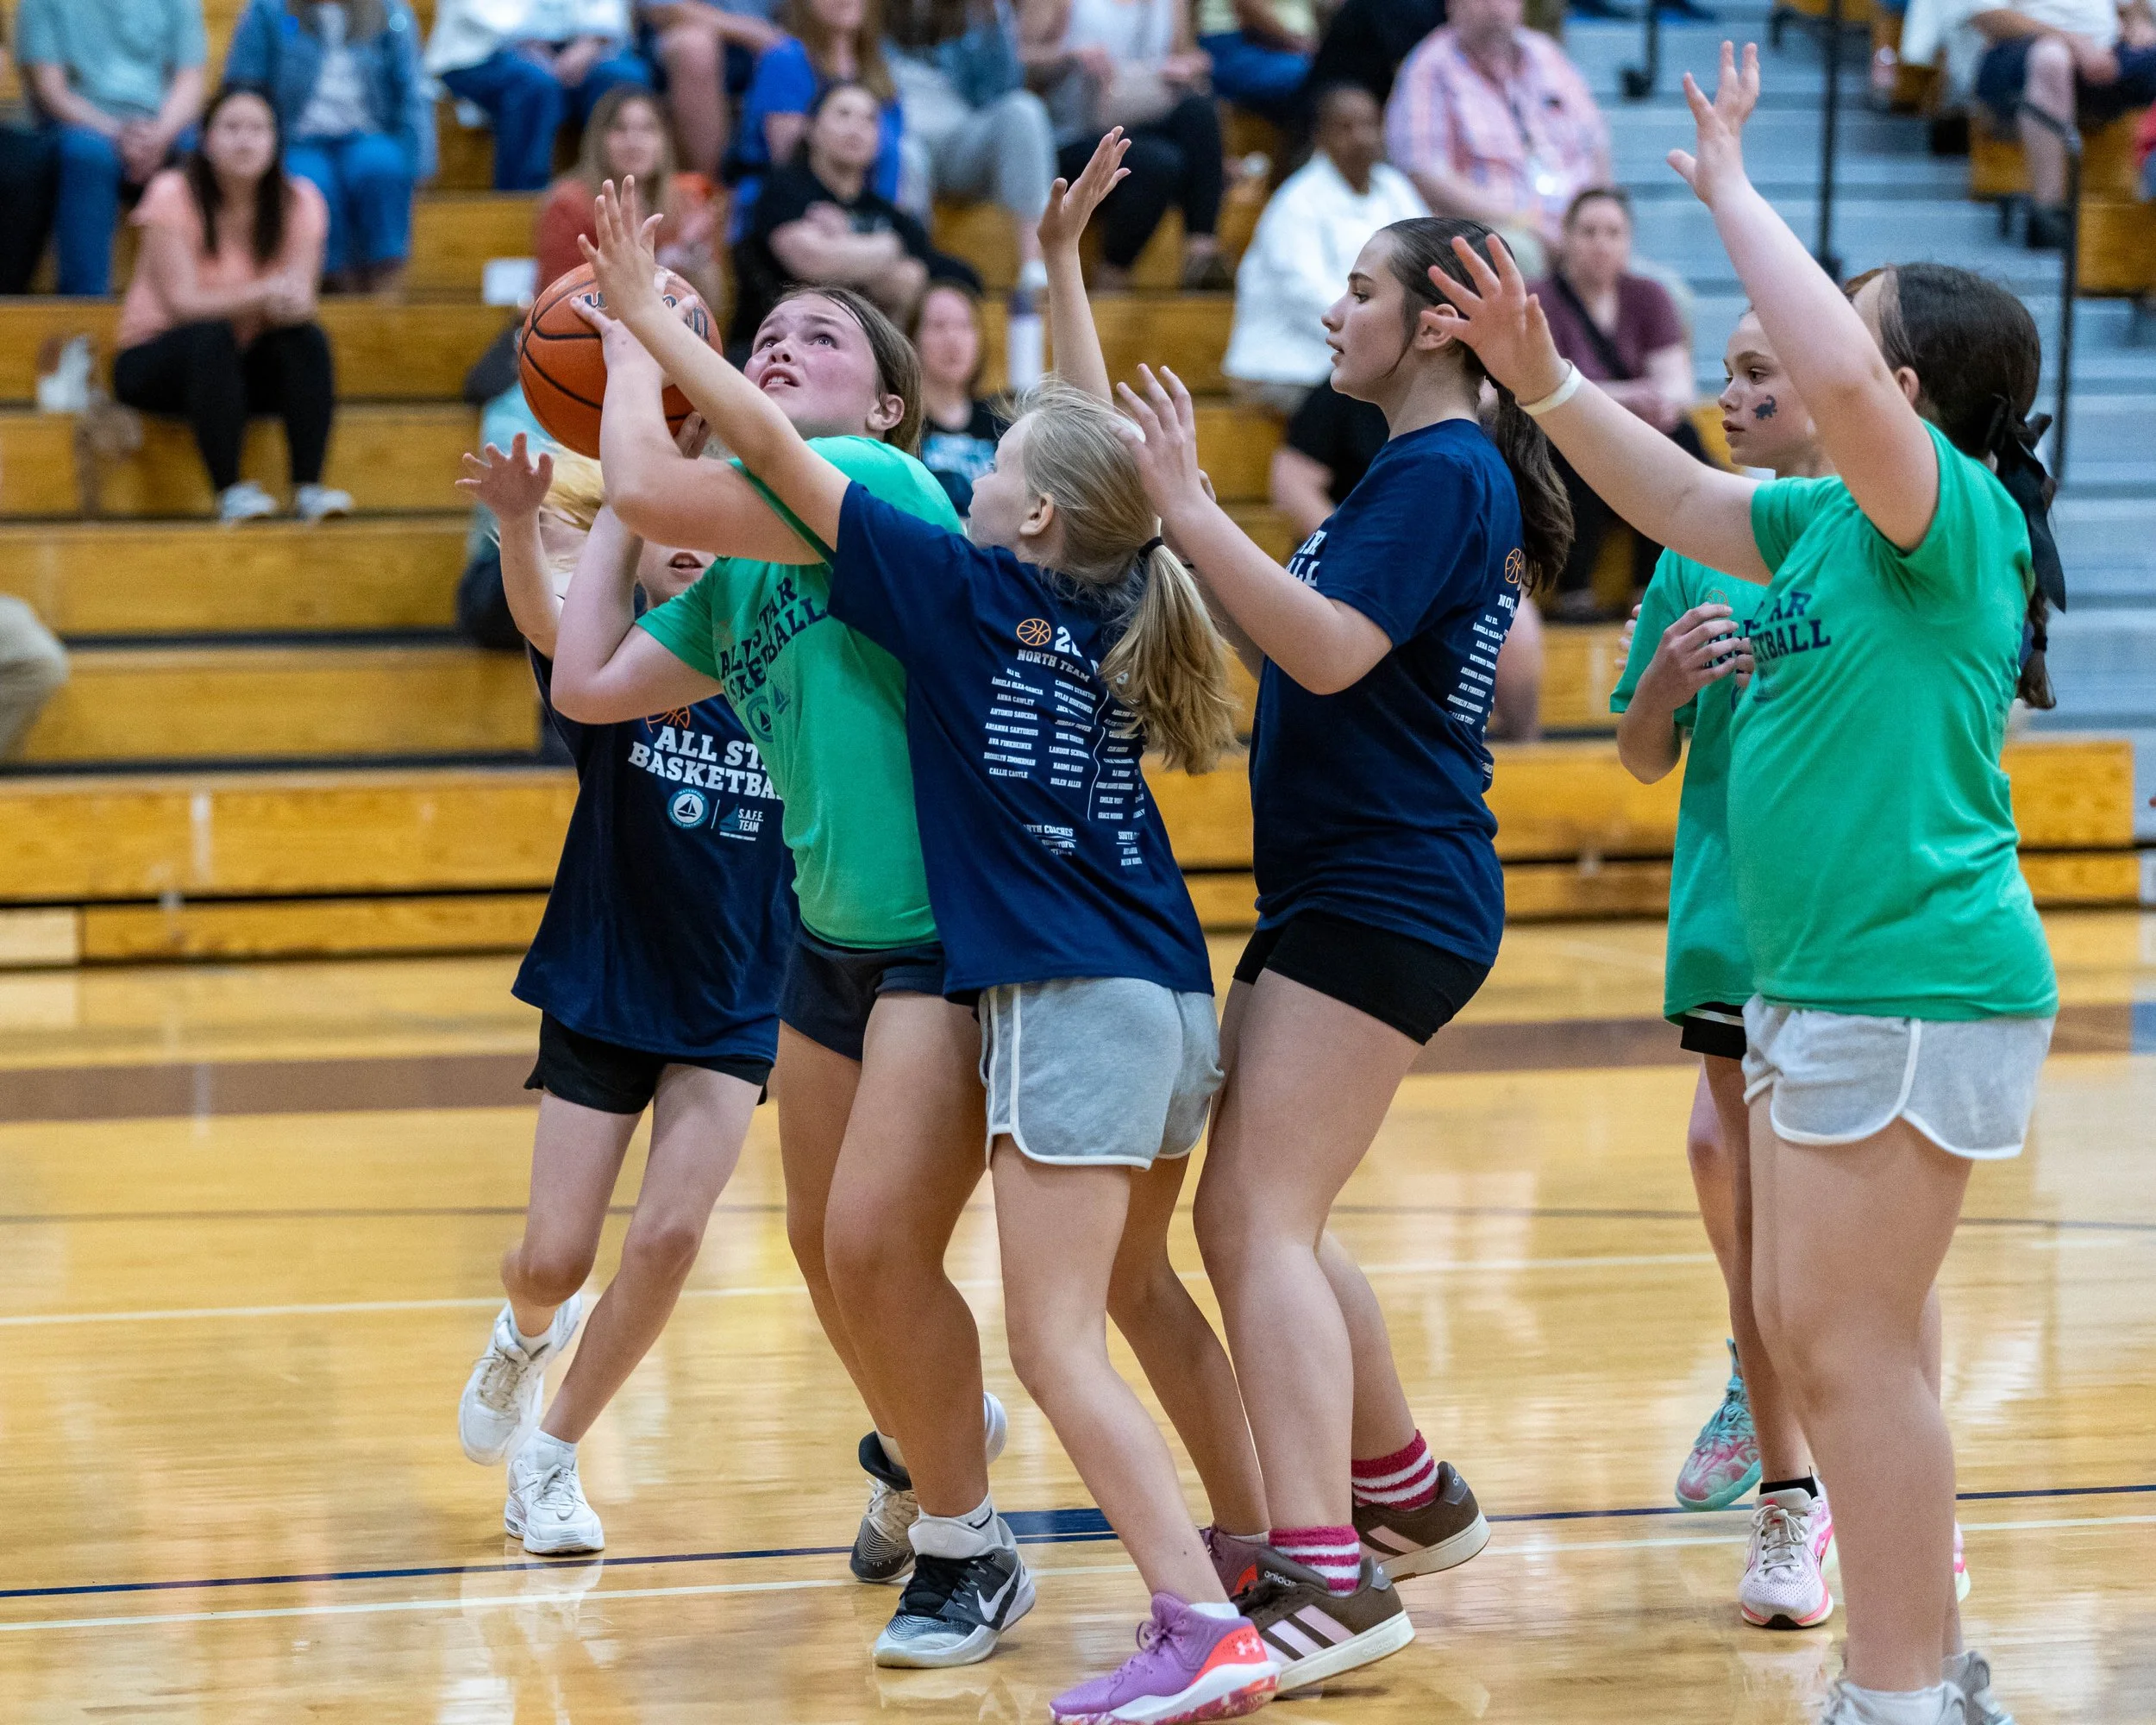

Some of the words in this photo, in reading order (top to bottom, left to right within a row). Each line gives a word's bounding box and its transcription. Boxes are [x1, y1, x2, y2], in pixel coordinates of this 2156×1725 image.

[1017, 648, 1058, 668] NORTH
[1060, 660, 1091, 683] TEAM
[996, 693, 1012, 702] ANNA
[989, 707, 1013, 717] ANTONIO
[654, 725, 718, 762] ALL
[724, 740, 767, 770] ST
[628, 741, 783, 800] BASKETBA
[989, 768, 1007, 776] CALLIE
[738, 808, 764, 822] S.A.F.E.
[738, 819, 760, 832] TEAM
[1044, 825, 1074, 837] COACHES
